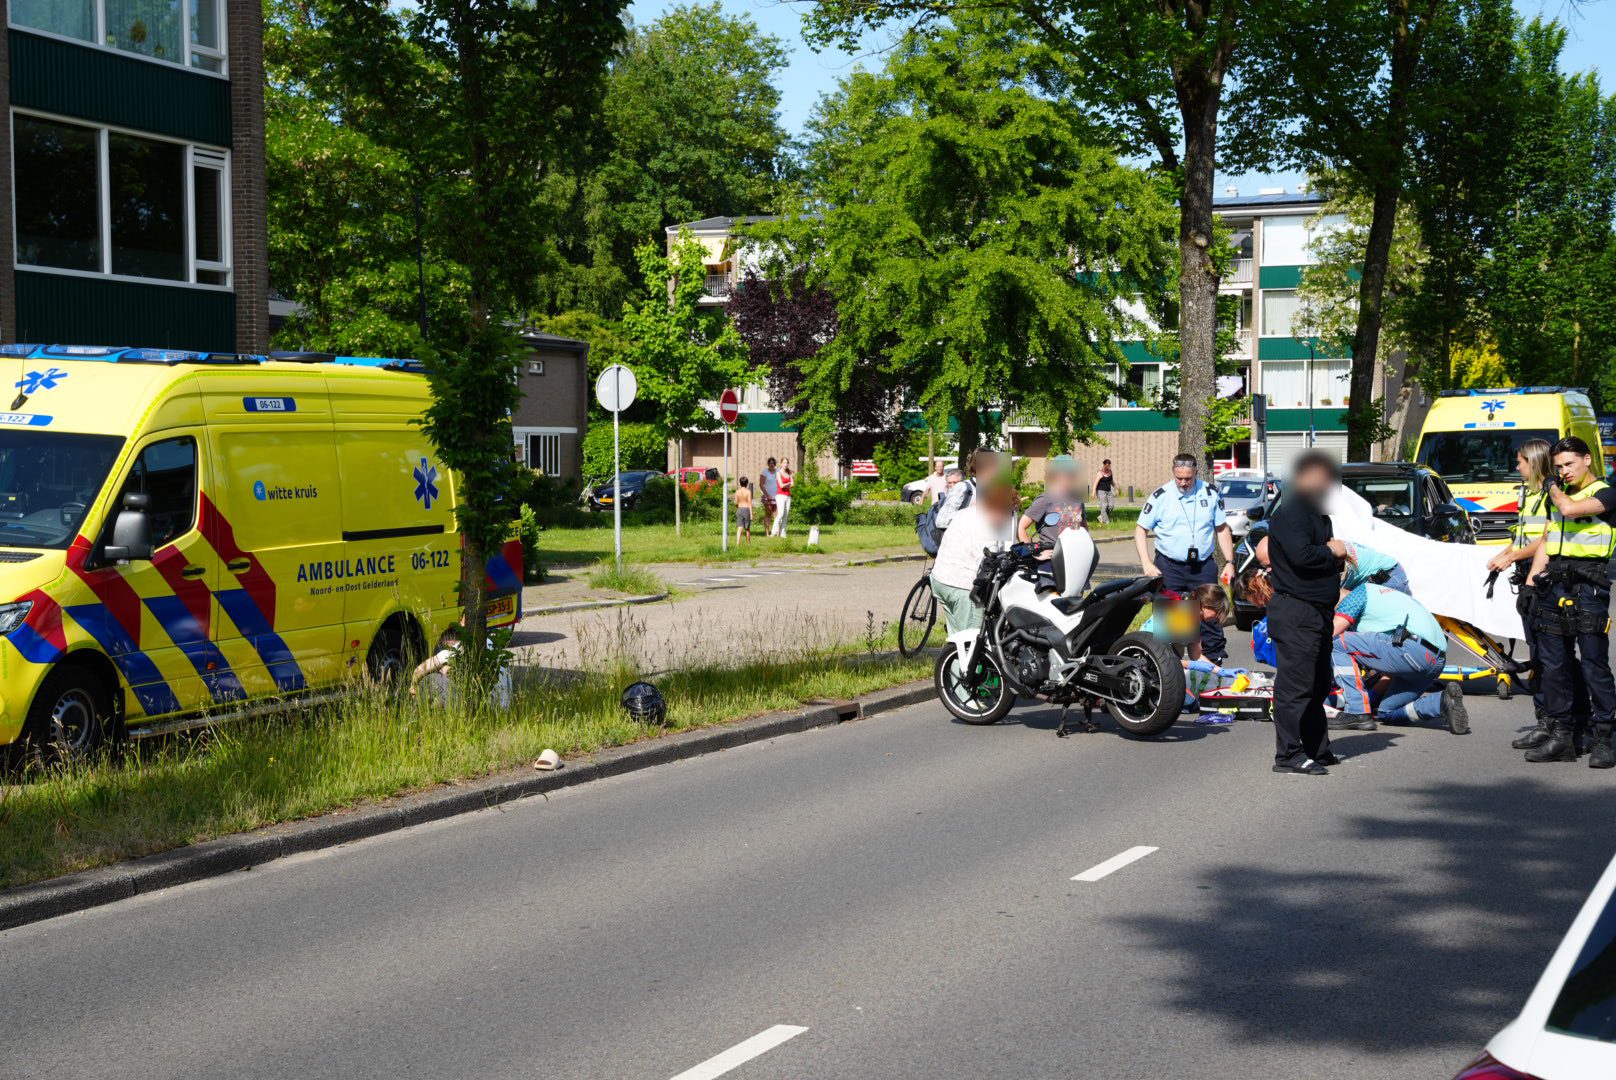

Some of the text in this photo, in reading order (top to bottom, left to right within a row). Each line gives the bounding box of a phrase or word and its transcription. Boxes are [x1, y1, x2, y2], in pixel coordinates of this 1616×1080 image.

[260, 400, 281, 409] 06-122
[268, 484, 318, 500] witte kruis
[297, 550, 450, 582] AMBULANCE 06-122
[310, 578, 399, 596] Noord- en Oost Gelderland
